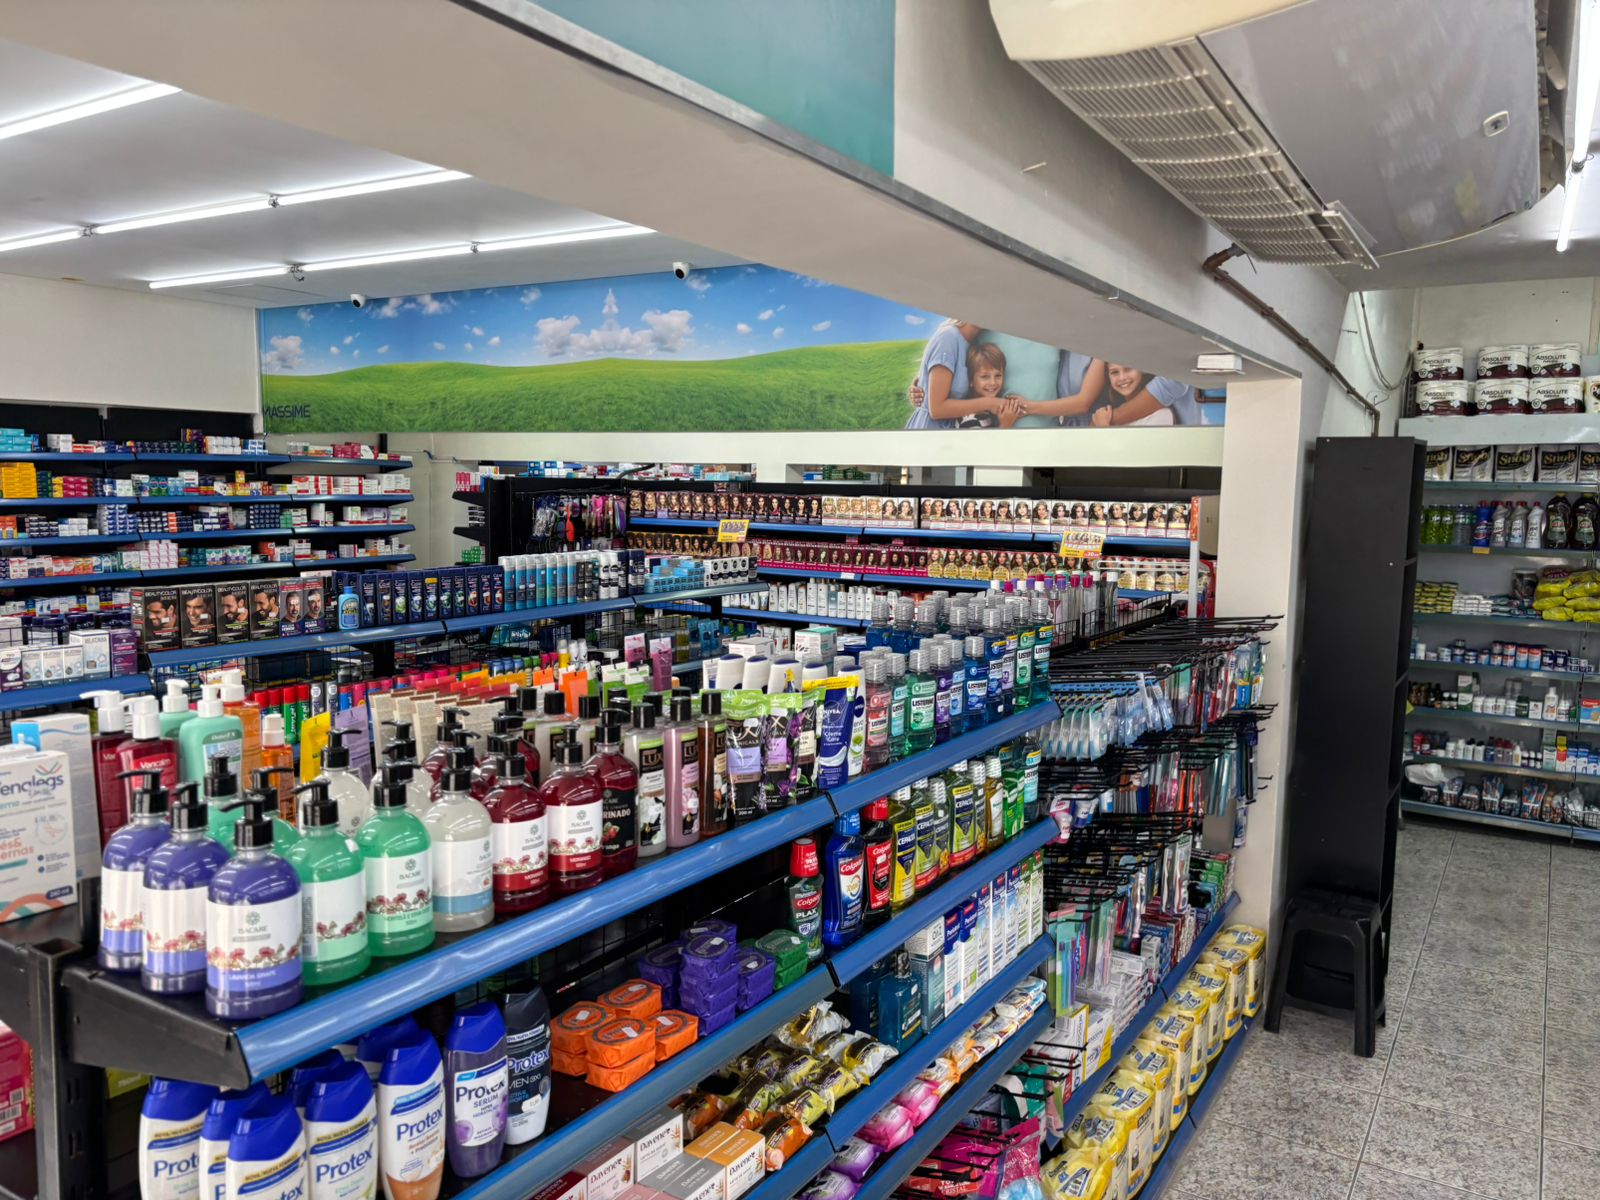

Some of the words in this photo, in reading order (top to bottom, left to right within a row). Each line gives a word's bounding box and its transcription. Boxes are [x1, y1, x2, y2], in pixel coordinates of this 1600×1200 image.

[1500, 453, 1531, 464] Snob
[1544, 452, 1575, 463] Snob
[0, 774, 64, 796] enalegs
[0, 846, 34, 859] ernas
[795, 908, 818, 919] PLAX
[473, 1094, 498, 1108] SERUM
[396, 1101, 444, 1141] Protex
[316, 1140, 374, 1183] Protex
